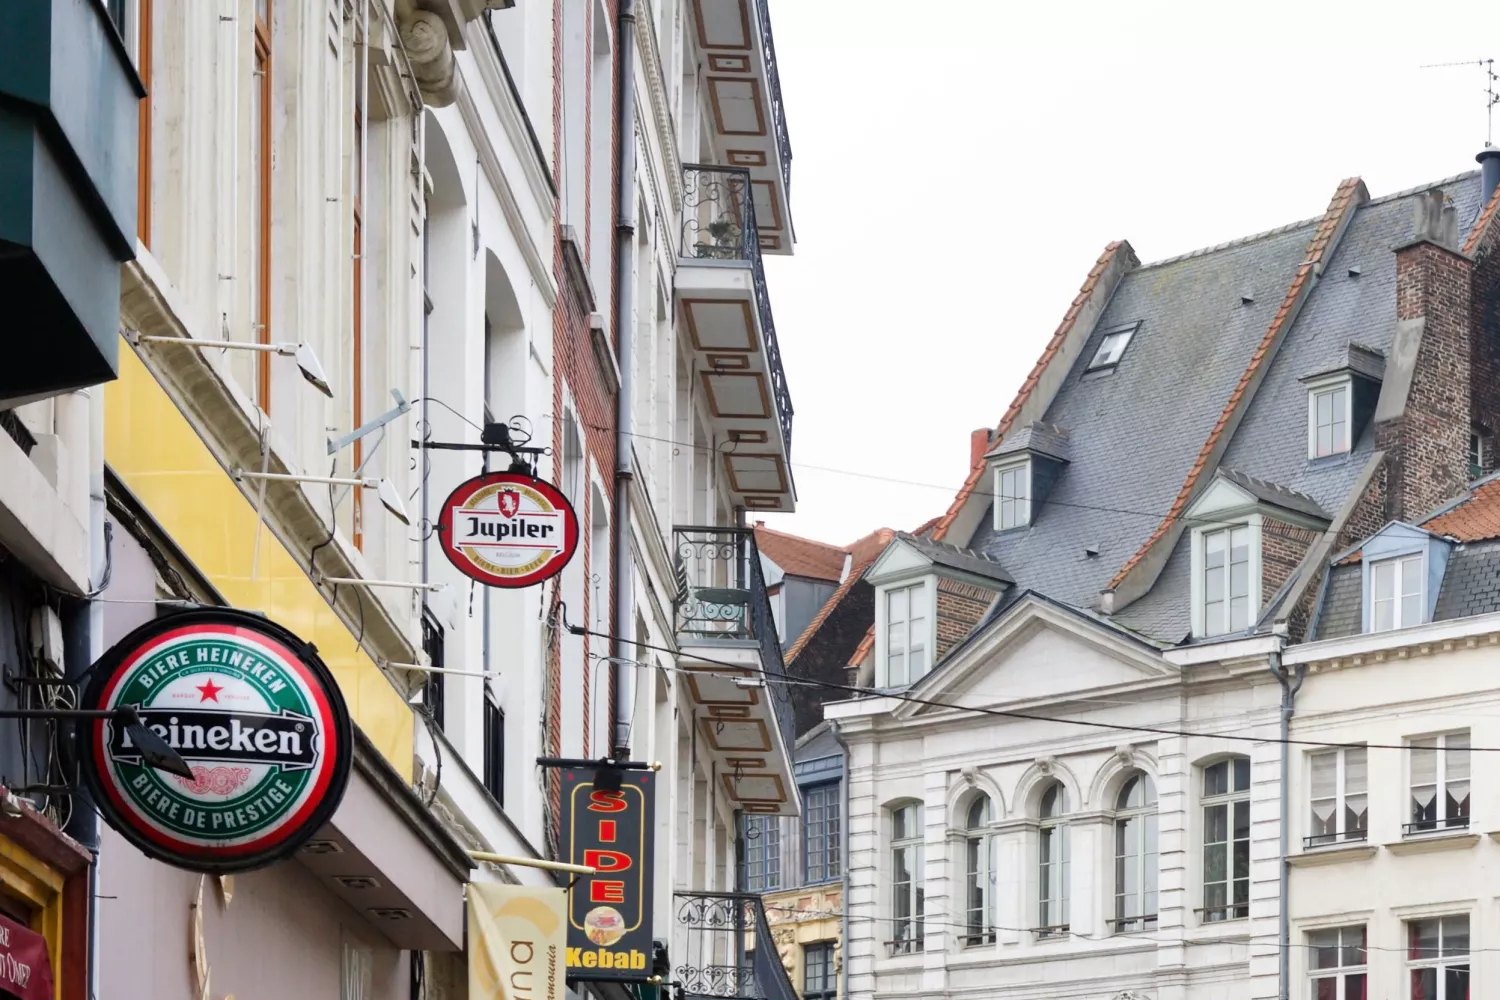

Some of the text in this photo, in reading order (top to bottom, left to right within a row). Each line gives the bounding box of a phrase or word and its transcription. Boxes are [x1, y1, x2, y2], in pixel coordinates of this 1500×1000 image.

[466, 517, 554, 542] Jupiler
[138, 647, 288, 694] BIERE HEINEKEN
[132, 773, 293, 829] BIERE DE PRESTIGE
[584, 790, 633, 904] SIDE
[566, 947, 646, 970] Kebab
